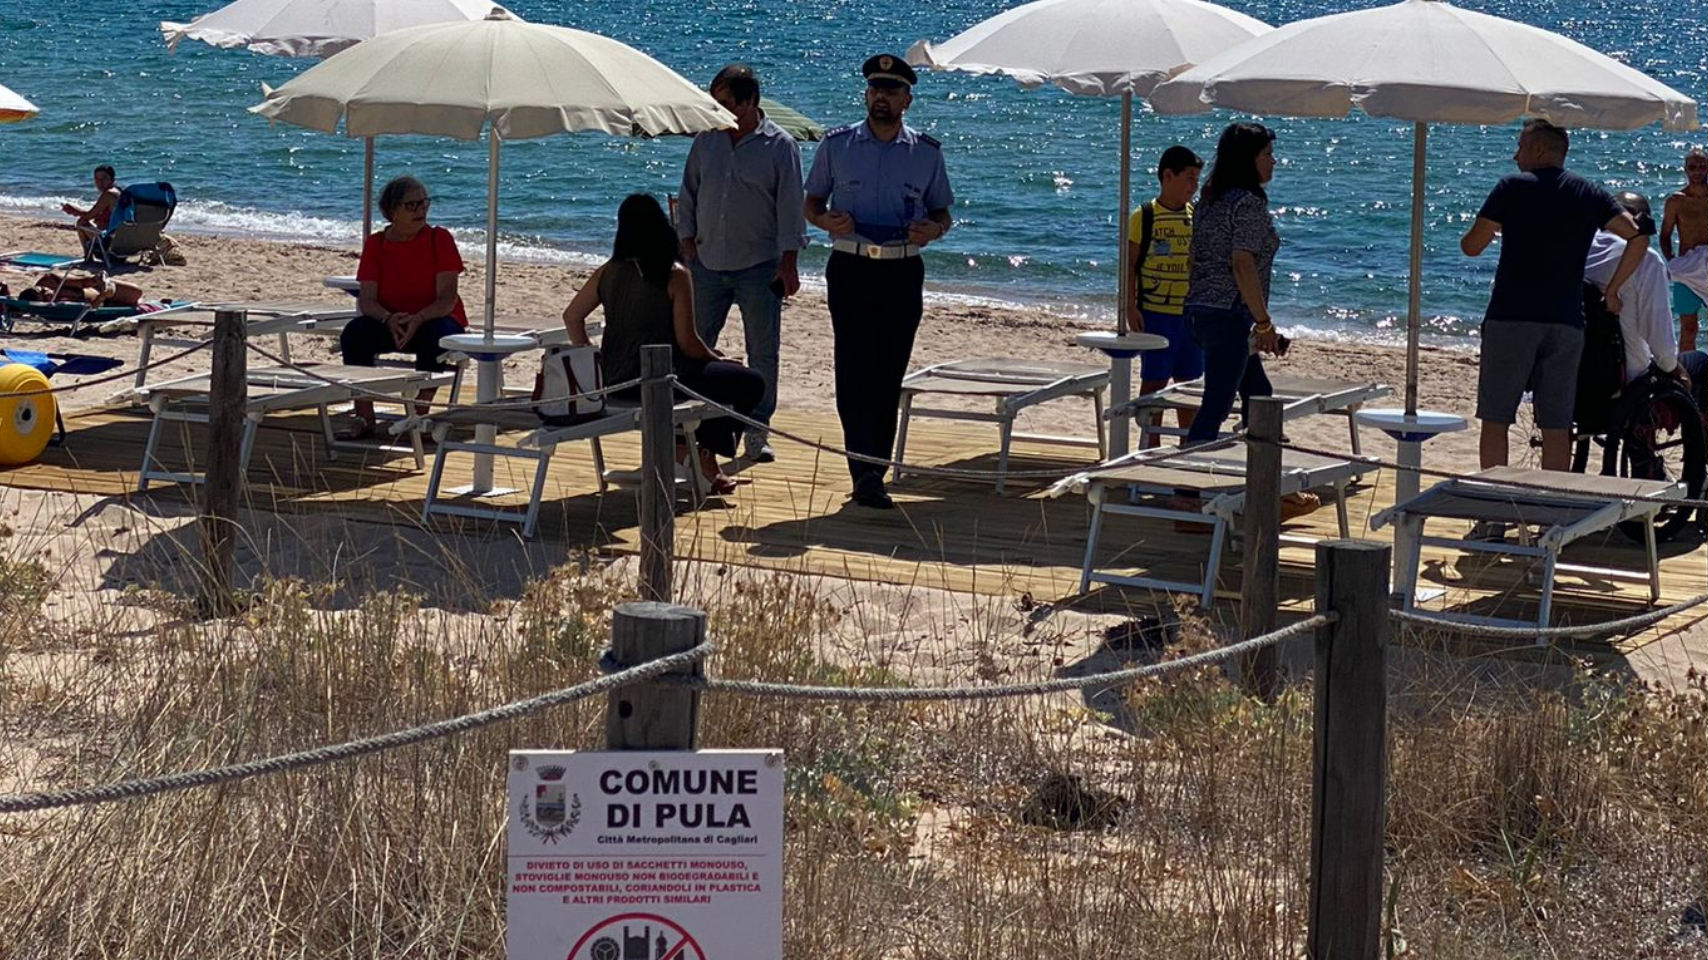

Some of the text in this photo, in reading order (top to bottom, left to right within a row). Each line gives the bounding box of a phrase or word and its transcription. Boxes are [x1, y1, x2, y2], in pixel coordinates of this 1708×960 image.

[600, 769, 758, 795] COMUNE
[607, 803, 751, 828] DI PULA
[597, 835, 758, 846] Città Metropolitana di Cagliari
[527, 861, 748, 870] DIVIETO DI USO DI SACCHETTI MONOUSO,
[515, 872, 759, 881] STOVIGLIE MONOUSO NON BIODEGRADABILI E
[512, 884, 761, 893] NON COMPOSTABILI, CORIANDOLI IN PLASTICA
[562, 895, 712, 904] E ALTRI PRODOTTI SIMILARI
